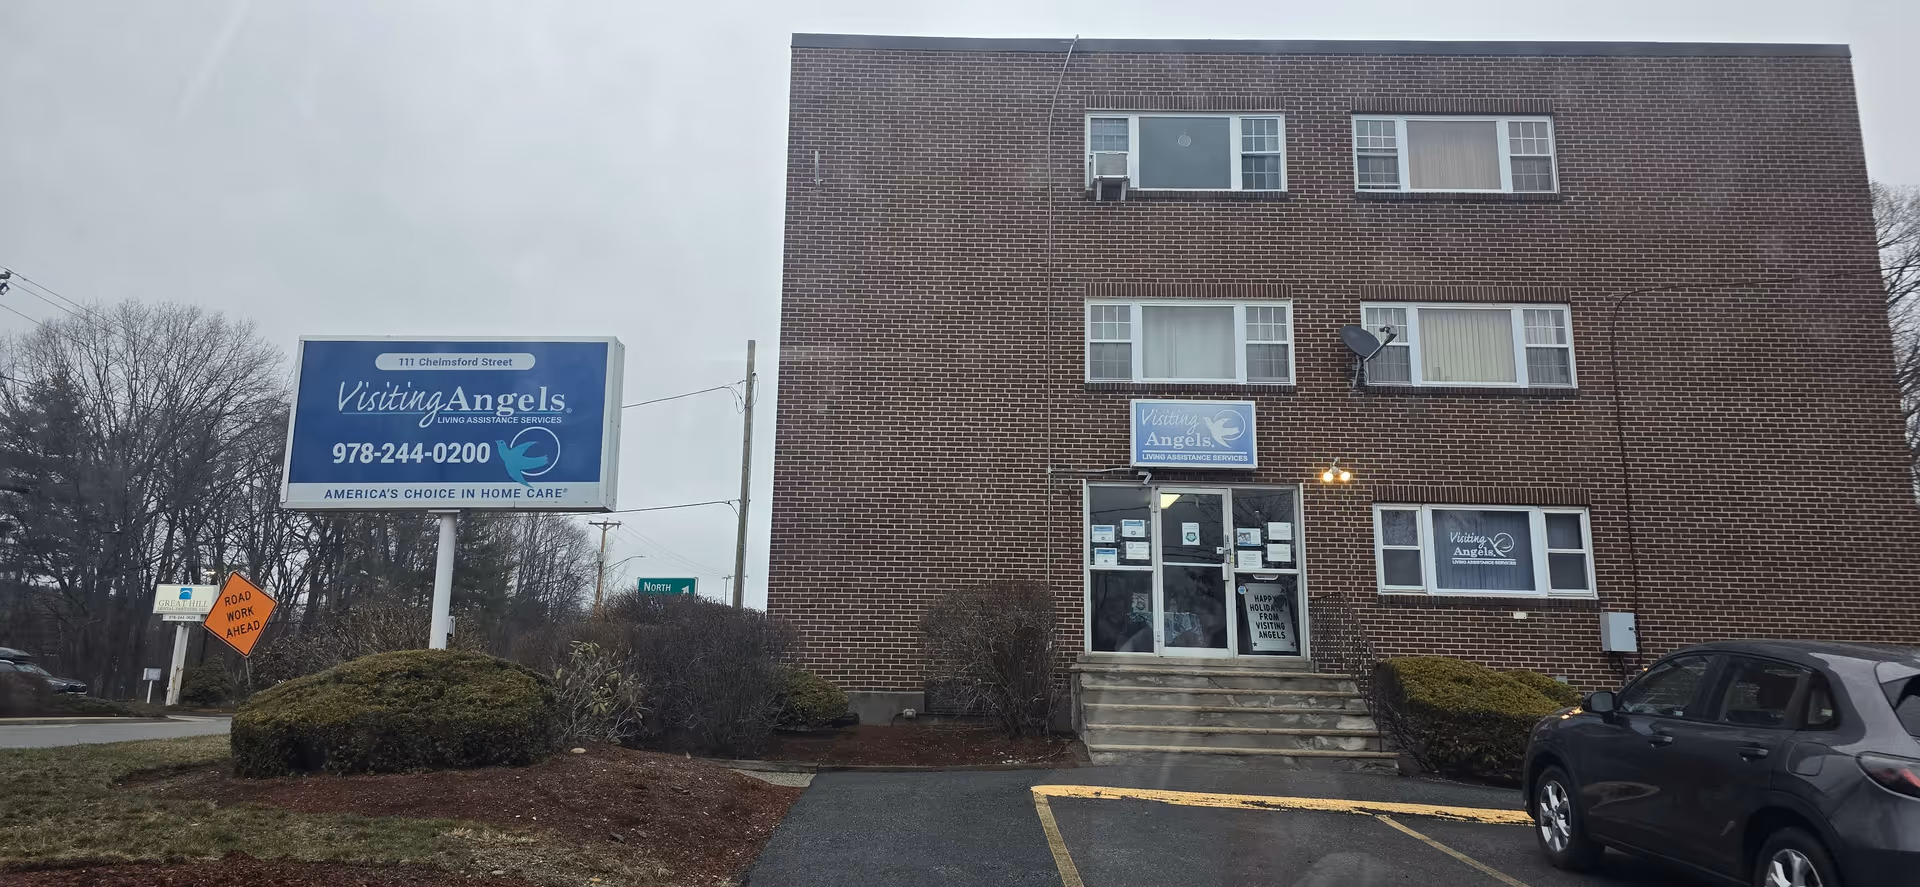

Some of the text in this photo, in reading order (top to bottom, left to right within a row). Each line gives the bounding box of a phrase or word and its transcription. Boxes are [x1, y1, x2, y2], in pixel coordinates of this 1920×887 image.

[398, 357, 513, 367] 111 Chelmsford Street
[337, 380, 446, 428] Visiting
[437, 416, 562, 424] LIVING ASSISTANCE SERVICES
[1141, 408, 1200, 435] Visiting
[332, 442, 491, 464] 978-244-0200
[324, 488, 399, 499] AMERICA'S
[404, 488, 456, 499] CHOICE
[461, 488, 475, 499] IN
[481, 488, 521, 498] HOME
[1450, 532, 1487, 548] Visiting
[644, 582, 671, 591] NORTH
[158, 599, 208, 608] GREAT HILL
[224, 590, 252, 607] ROAD
[1250, 604, 1284, 612] HOLIDA
[226, 605, 255, 622] WORK
[1259, 612, 1280, 621] FROM
[226, 620, 261, 639] AHEAD
[1256, 621, 1286, 630] VISITING
[1259, 630, 1286, 639] ANGELS
